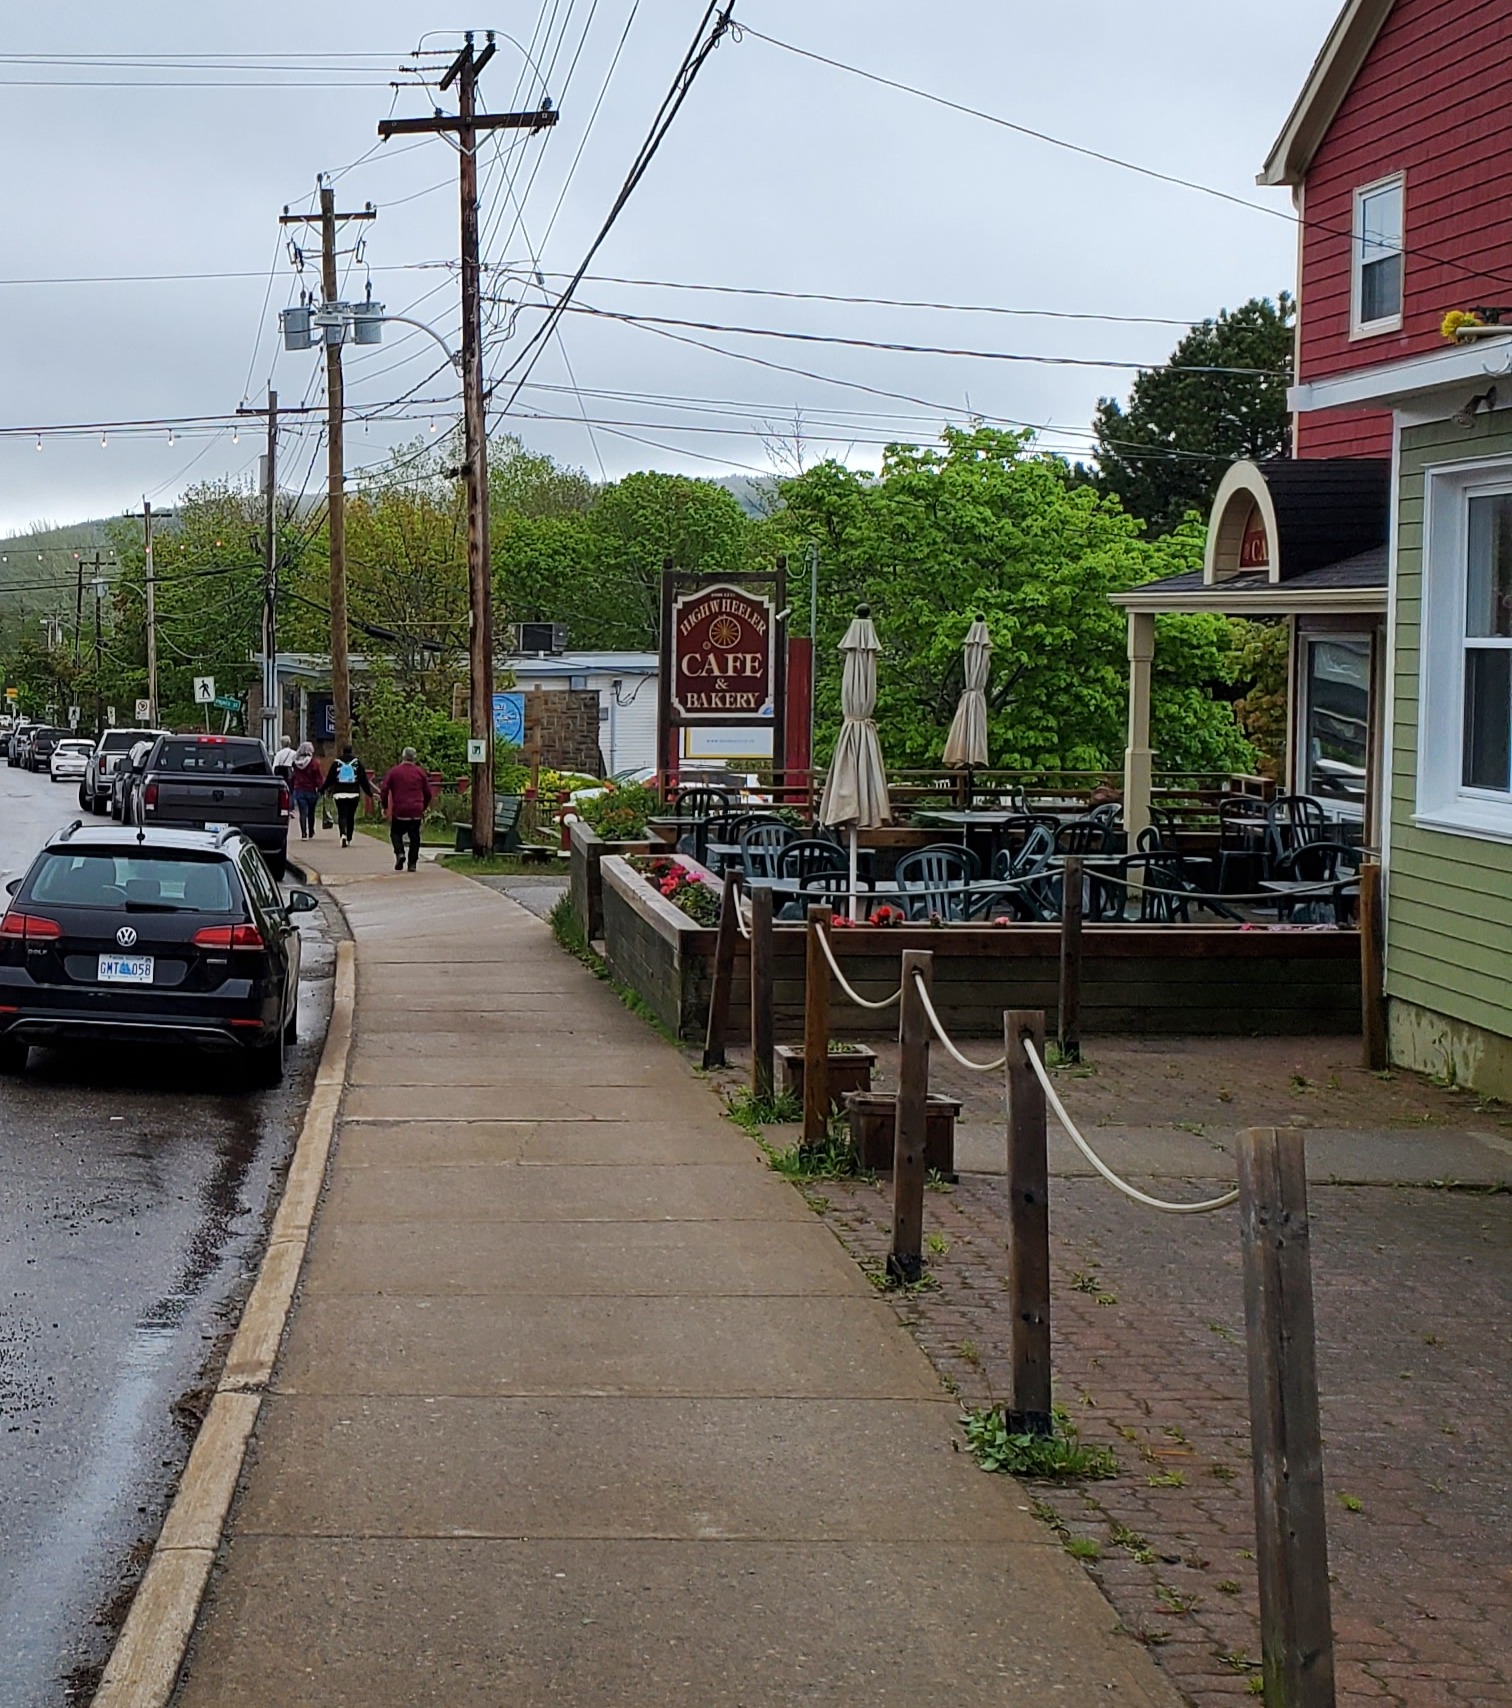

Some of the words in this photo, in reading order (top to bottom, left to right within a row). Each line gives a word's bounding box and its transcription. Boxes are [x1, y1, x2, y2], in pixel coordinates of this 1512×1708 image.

[680, 600, 767, 637] HIGHWHEELER
[681, 653, 764, 678] CAFE
[715, 678, 729, 690] &
[686, 692, 760, 708] BAKERY
[100, 962, 119, 974] GMT
[132, 963, 151, 976] 058
